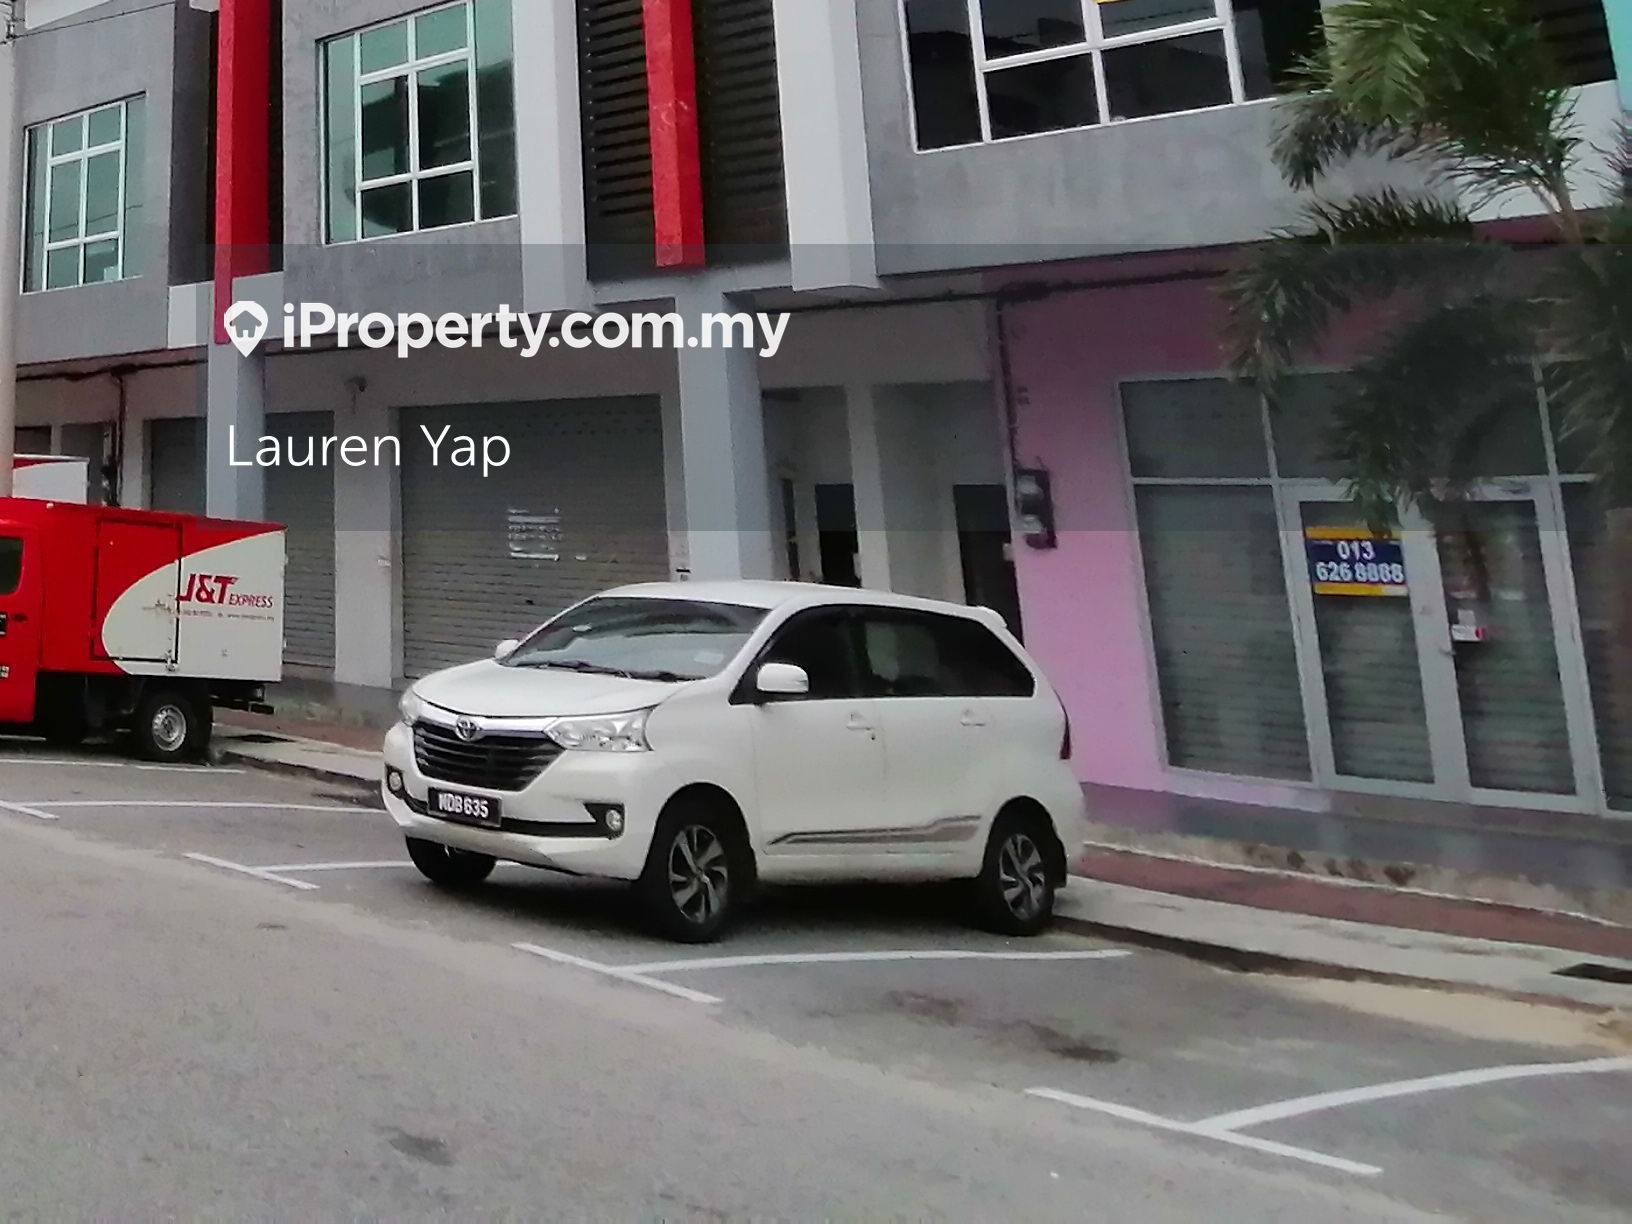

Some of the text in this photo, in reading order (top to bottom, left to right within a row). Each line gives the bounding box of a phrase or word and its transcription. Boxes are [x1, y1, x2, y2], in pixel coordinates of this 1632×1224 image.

[1336, 540, 1376, 560] 013
[1315, 561, 1404, 583] 626 8888
[176, 573, 273, 608] J&T EXPRESS
[463, 796, 489, 818] 635
